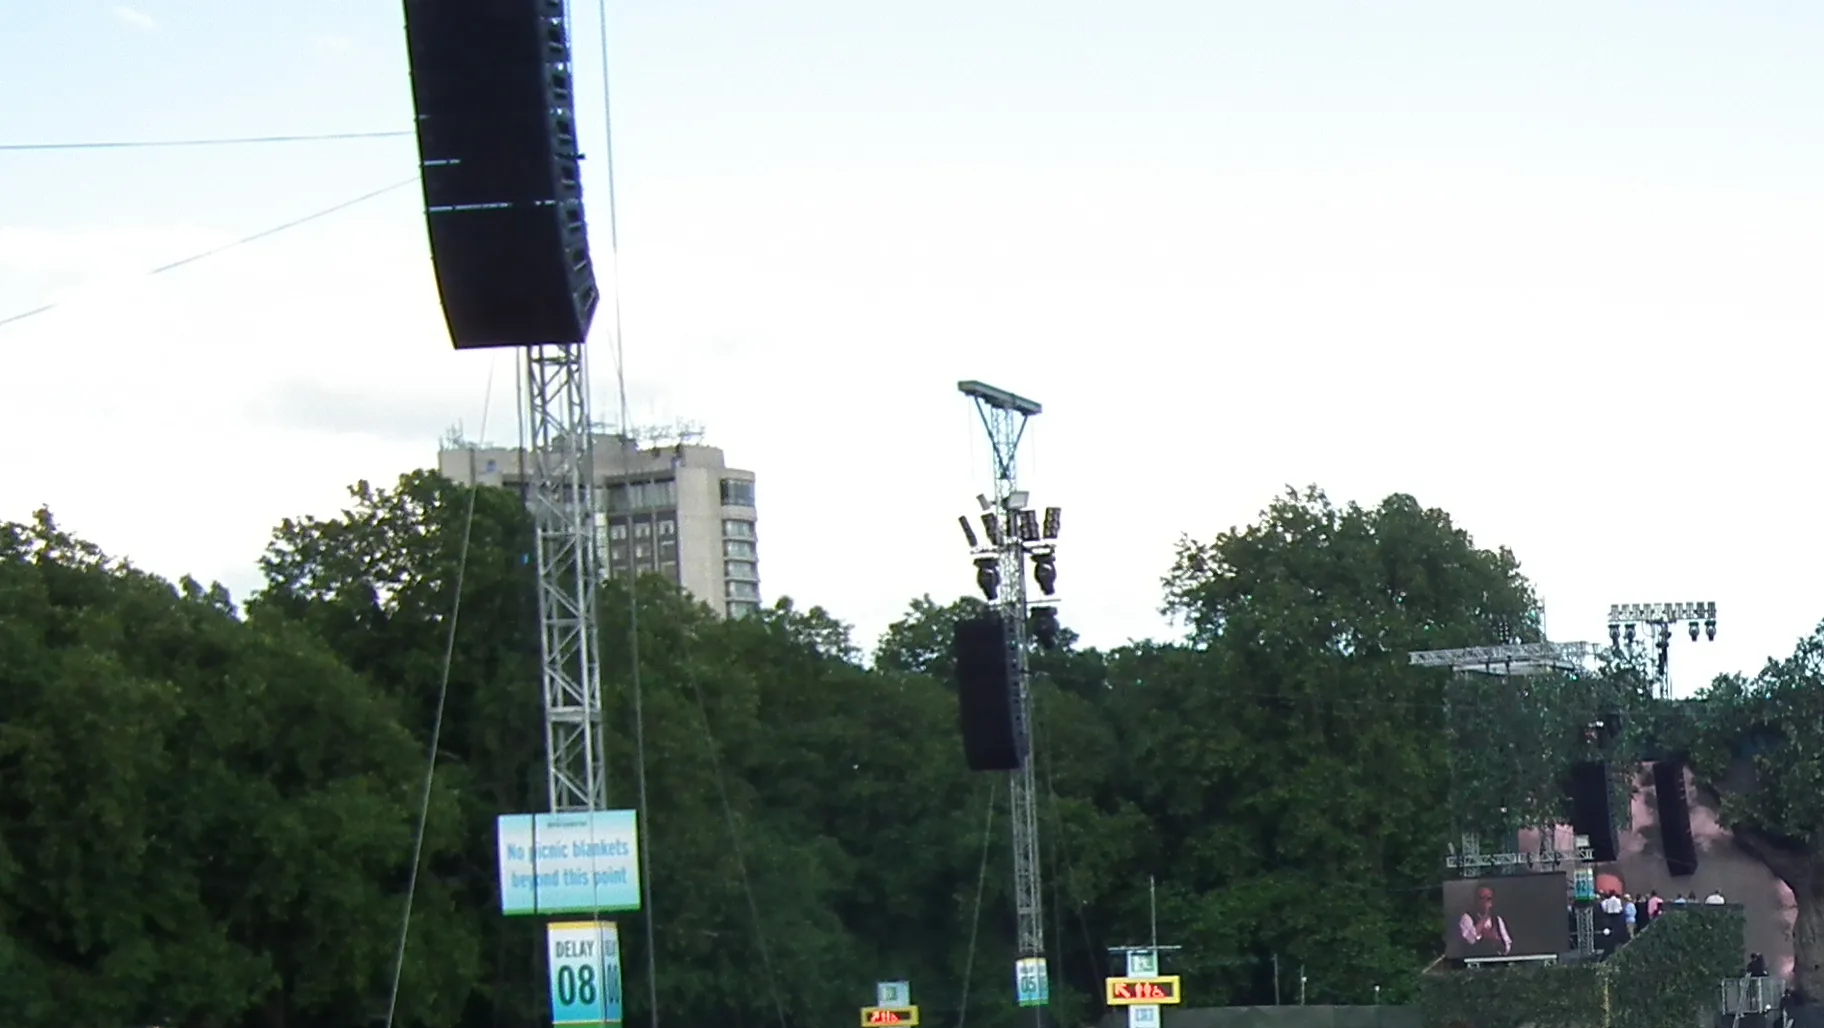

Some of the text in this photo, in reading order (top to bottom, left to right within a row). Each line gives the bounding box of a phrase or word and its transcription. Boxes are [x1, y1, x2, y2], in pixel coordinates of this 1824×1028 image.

[507, 843, 525, 860] No
[572, 839, 630, 858] blankets
[511, 866, 627, 891] beyond this point
[555, 940, 595, 958] DELAY
[558, 963, 597, 1006] 08
